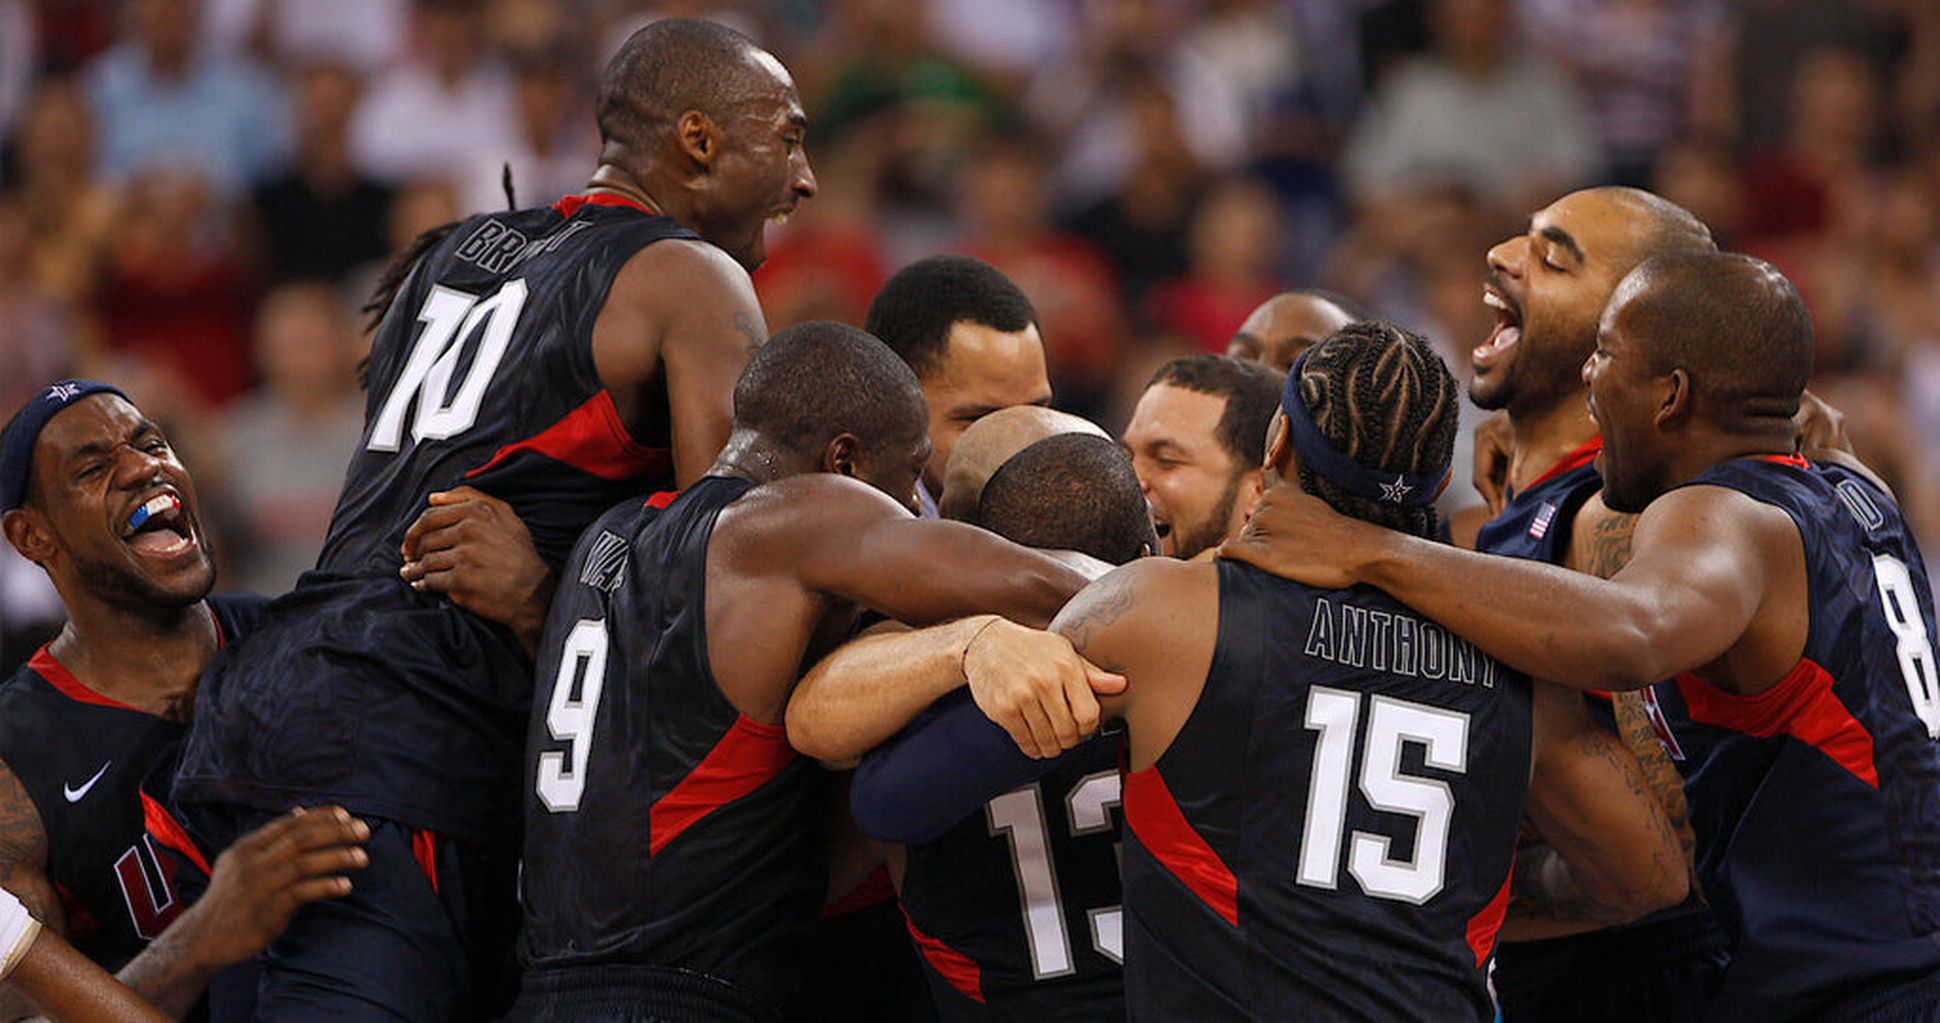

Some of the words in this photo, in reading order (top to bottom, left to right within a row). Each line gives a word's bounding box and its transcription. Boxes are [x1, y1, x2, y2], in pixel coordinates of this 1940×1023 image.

[366, 277, 529, 452] 10
[536, 617, 609, 813] 9
[1866, 552, 1940, 740] 8
[1296, 684, 1471, 906] 15
